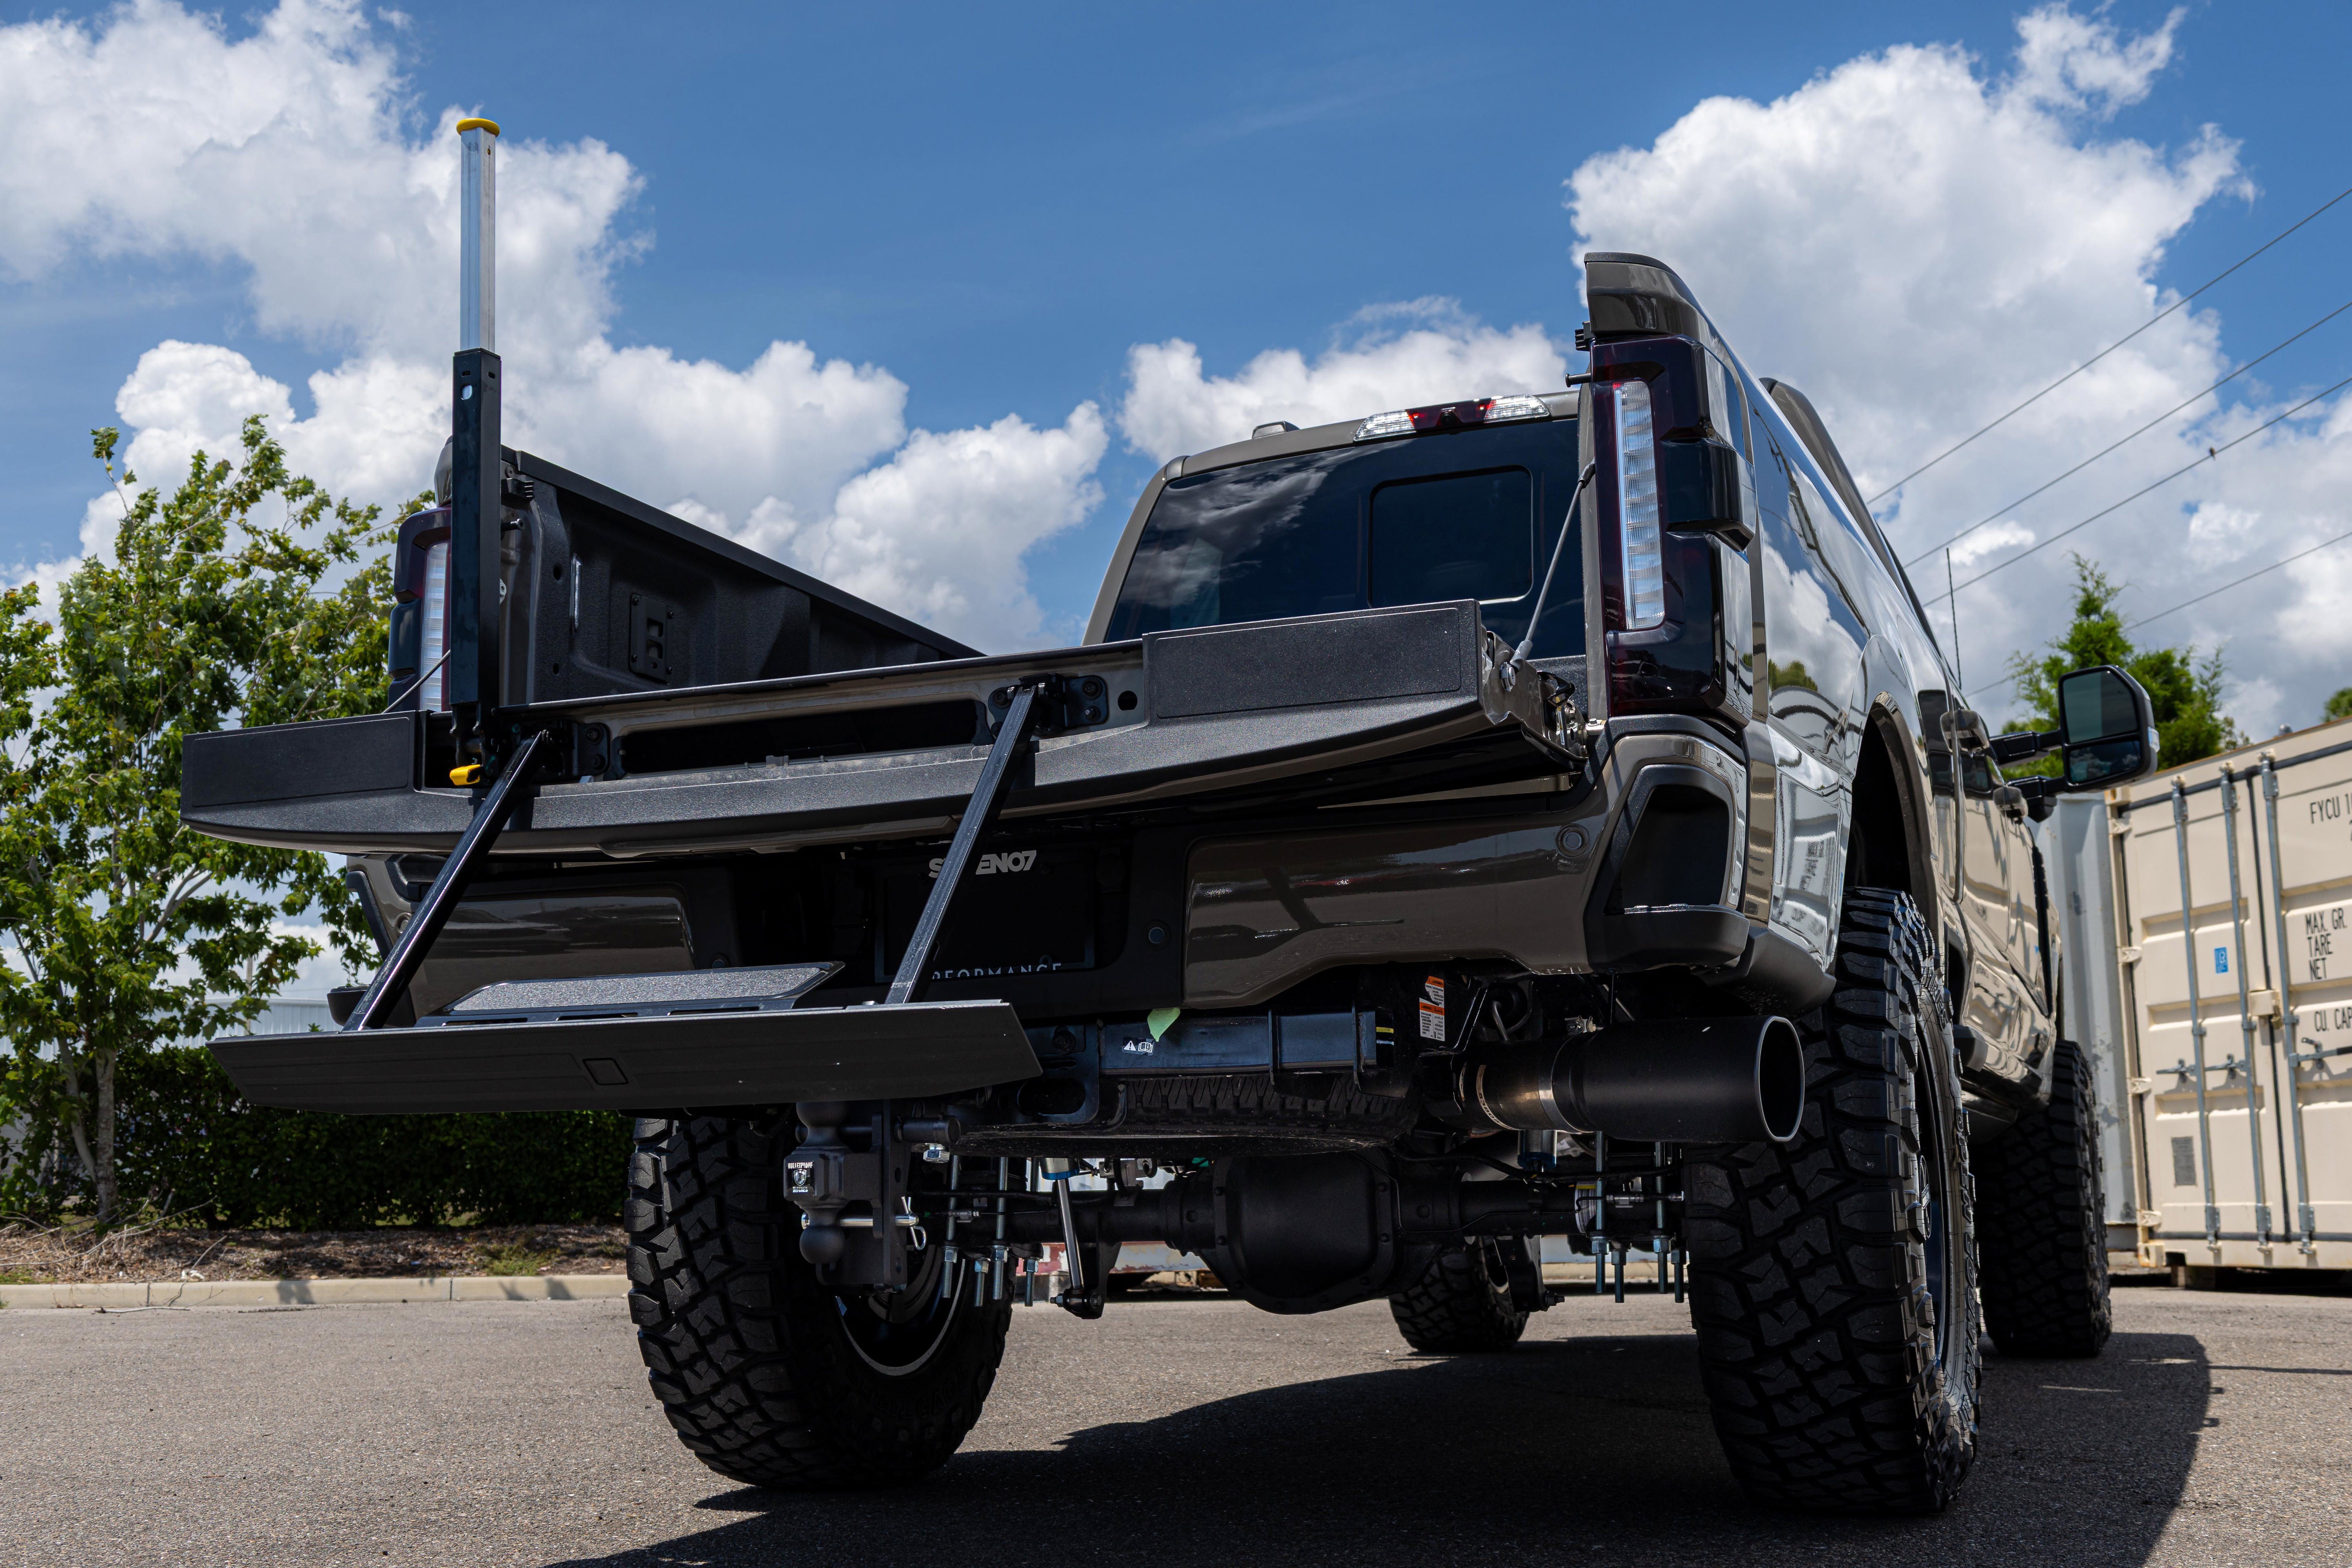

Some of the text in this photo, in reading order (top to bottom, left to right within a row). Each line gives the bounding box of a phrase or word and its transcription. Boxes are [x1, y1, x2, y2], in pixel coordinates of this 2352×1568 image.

[2310, 796, 2341, 824] FYCU
[2305, 907, 2348, 935] MAX. GR.
[2307, 933, 2333, 958] TARE
[2309, 958, 2327, 981] NET
[2314, 1010, 2330, 1032] CU.
